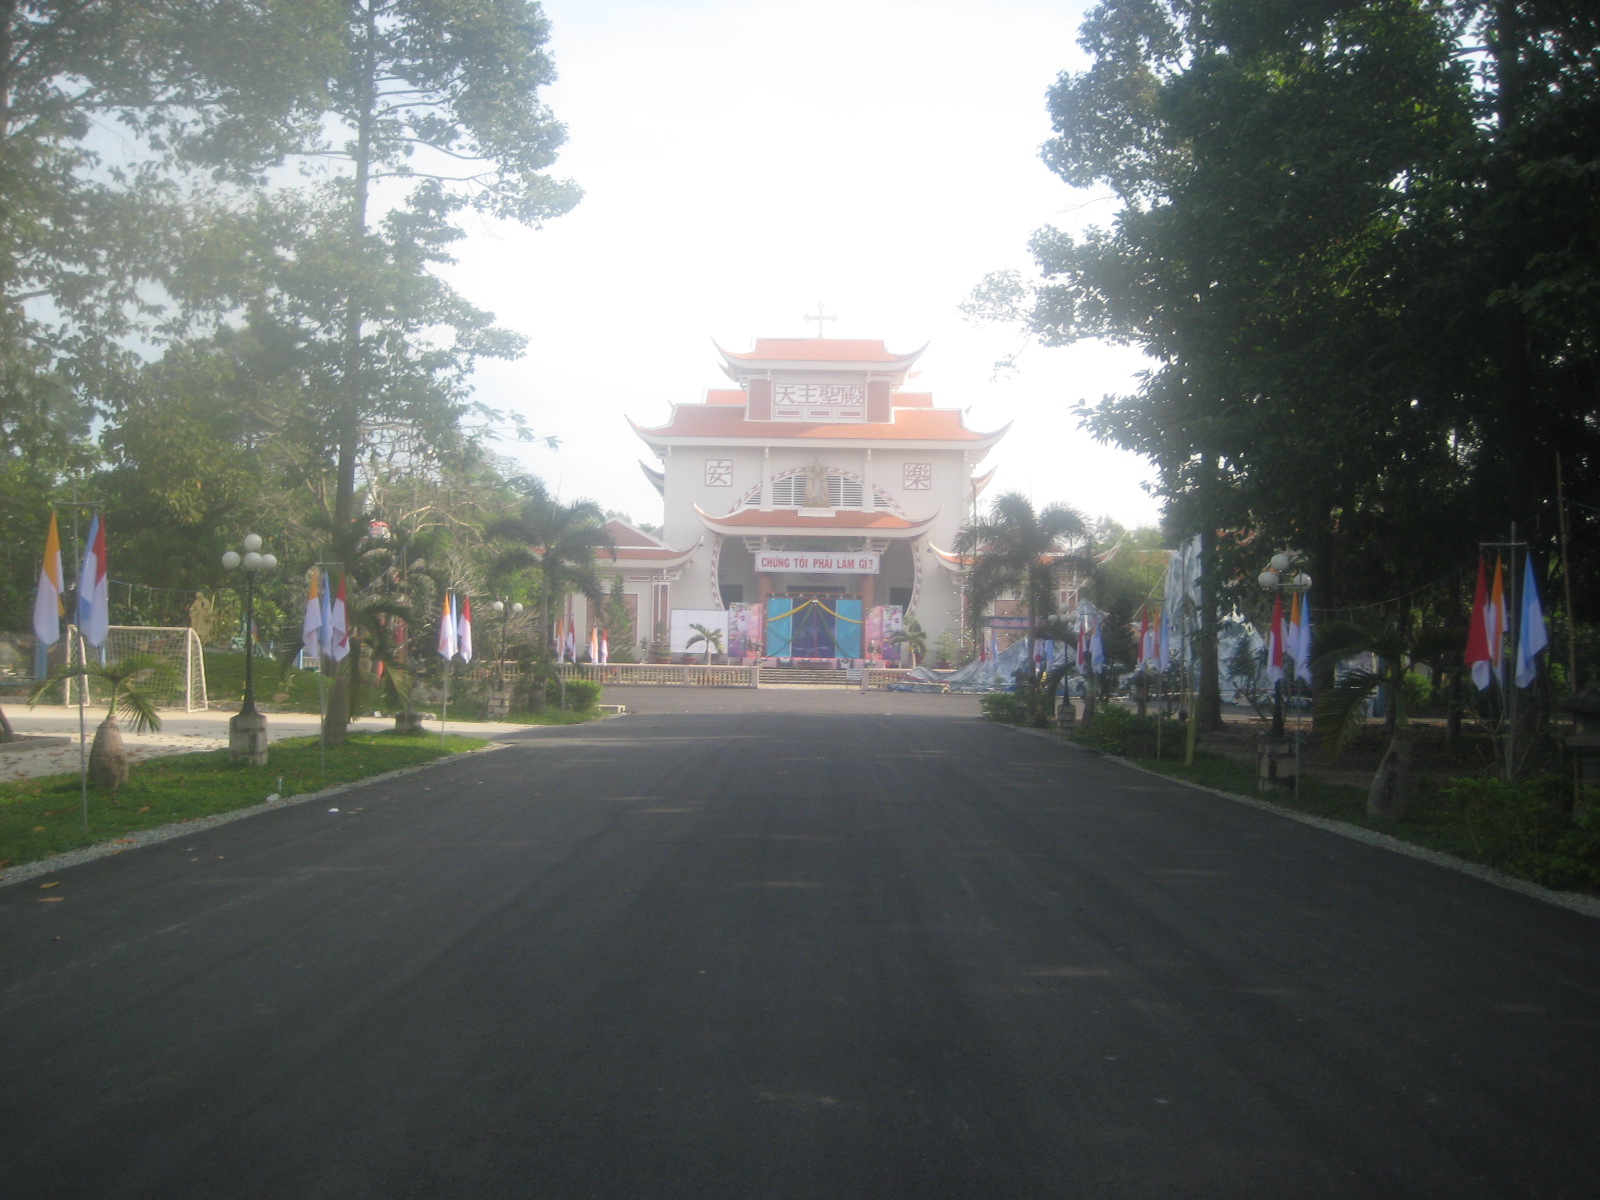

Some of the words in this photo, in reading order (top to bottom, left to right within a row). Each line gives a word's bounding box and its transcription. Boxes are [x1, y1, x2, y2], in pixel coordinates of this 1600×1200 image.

[707, 460, 731, 485] 安
[905, 464, 930, 489] 樂
[761, 555, 790, 568] CHÚNG
[794, 555, 808, 568] TÔI
[813, 555, 833, 569] PHẢI
